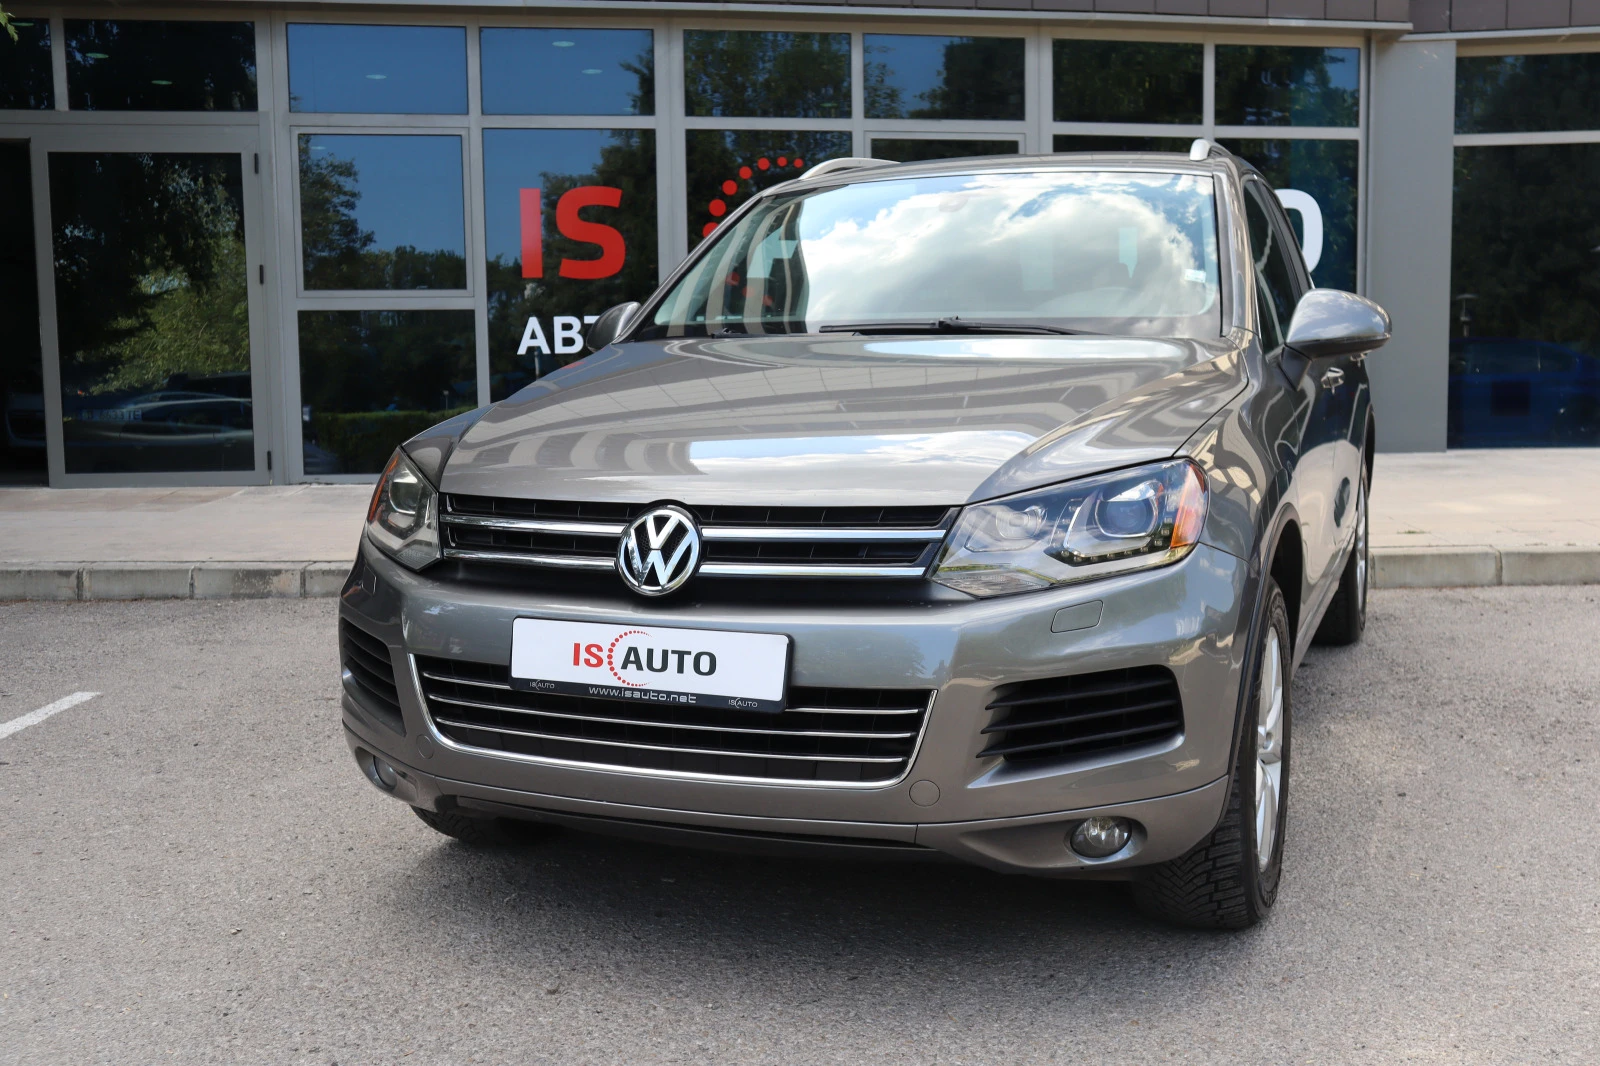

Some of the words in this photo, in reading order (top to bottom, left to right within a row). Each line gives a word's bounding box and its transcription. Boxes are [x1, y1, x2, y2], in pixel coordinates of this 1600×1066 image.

[519, 186, 626, 279] IS
[621, 509, 697, 591] VW
[573, 642, 604, 668] IS
[620, 646, 717, 677] AUTO
[588, 686, 697, 704] www.isauto.net
